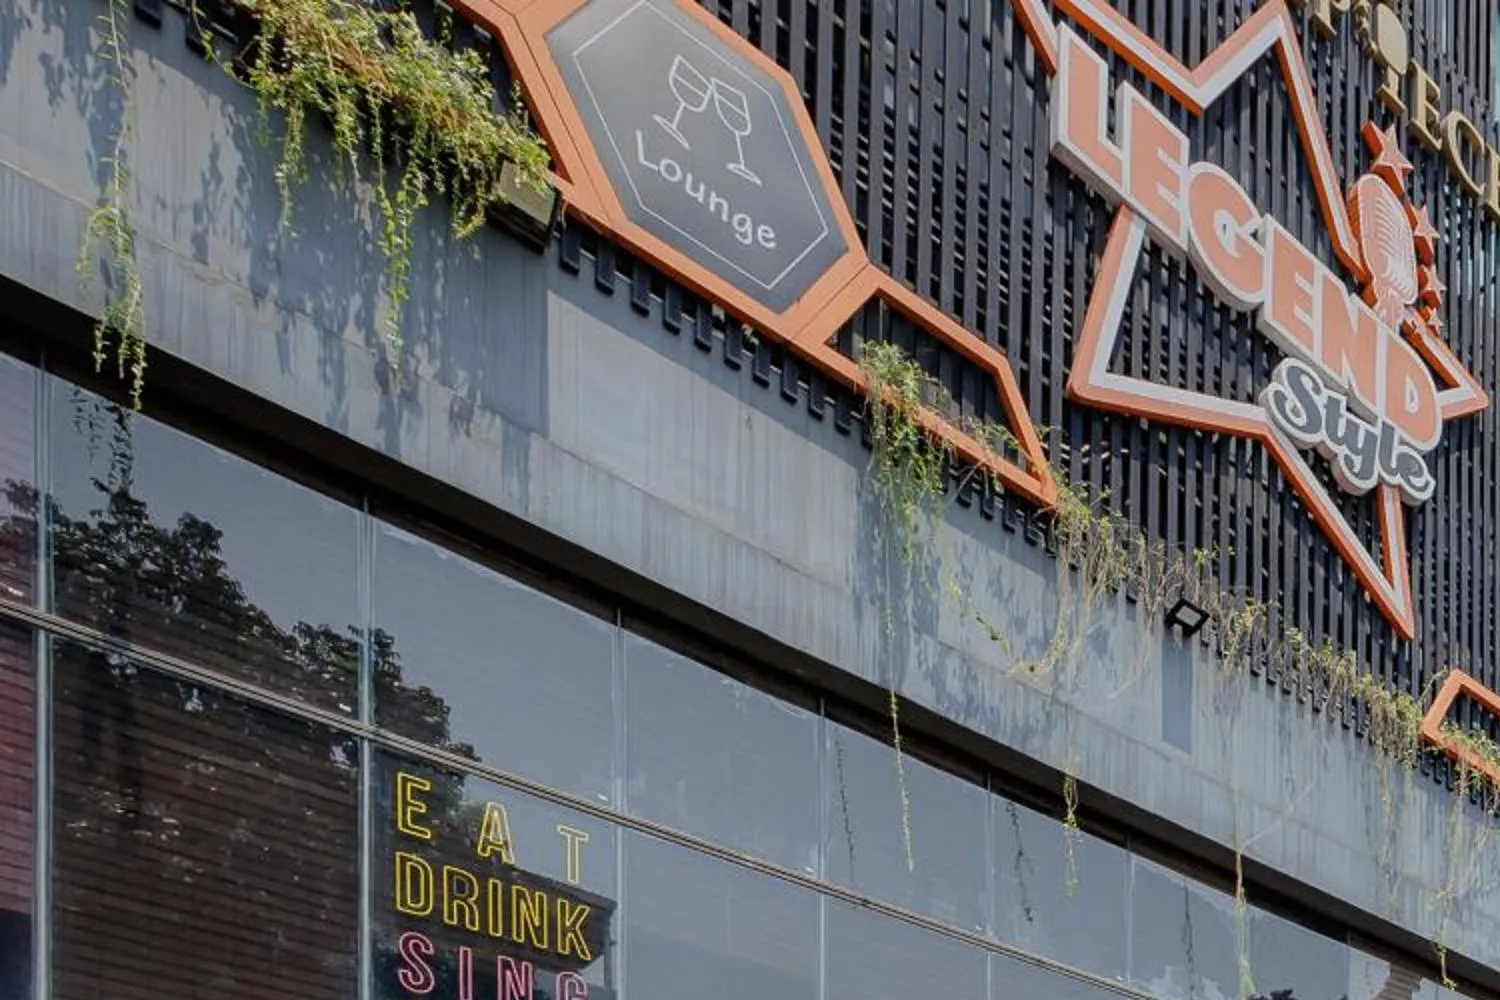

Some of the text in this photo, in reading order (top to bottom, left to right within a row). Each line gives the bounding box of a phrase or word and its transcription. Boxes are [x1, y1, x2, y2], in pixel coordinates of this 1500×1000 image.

[634, 128, 778, 250] Lounge
[1051, 22, 1442, 451] LEGEND
[1259, 357, 1436, 506] Style
[396, 771, 590, 885] EAT
[395, 851, 592, 961] DRINK
